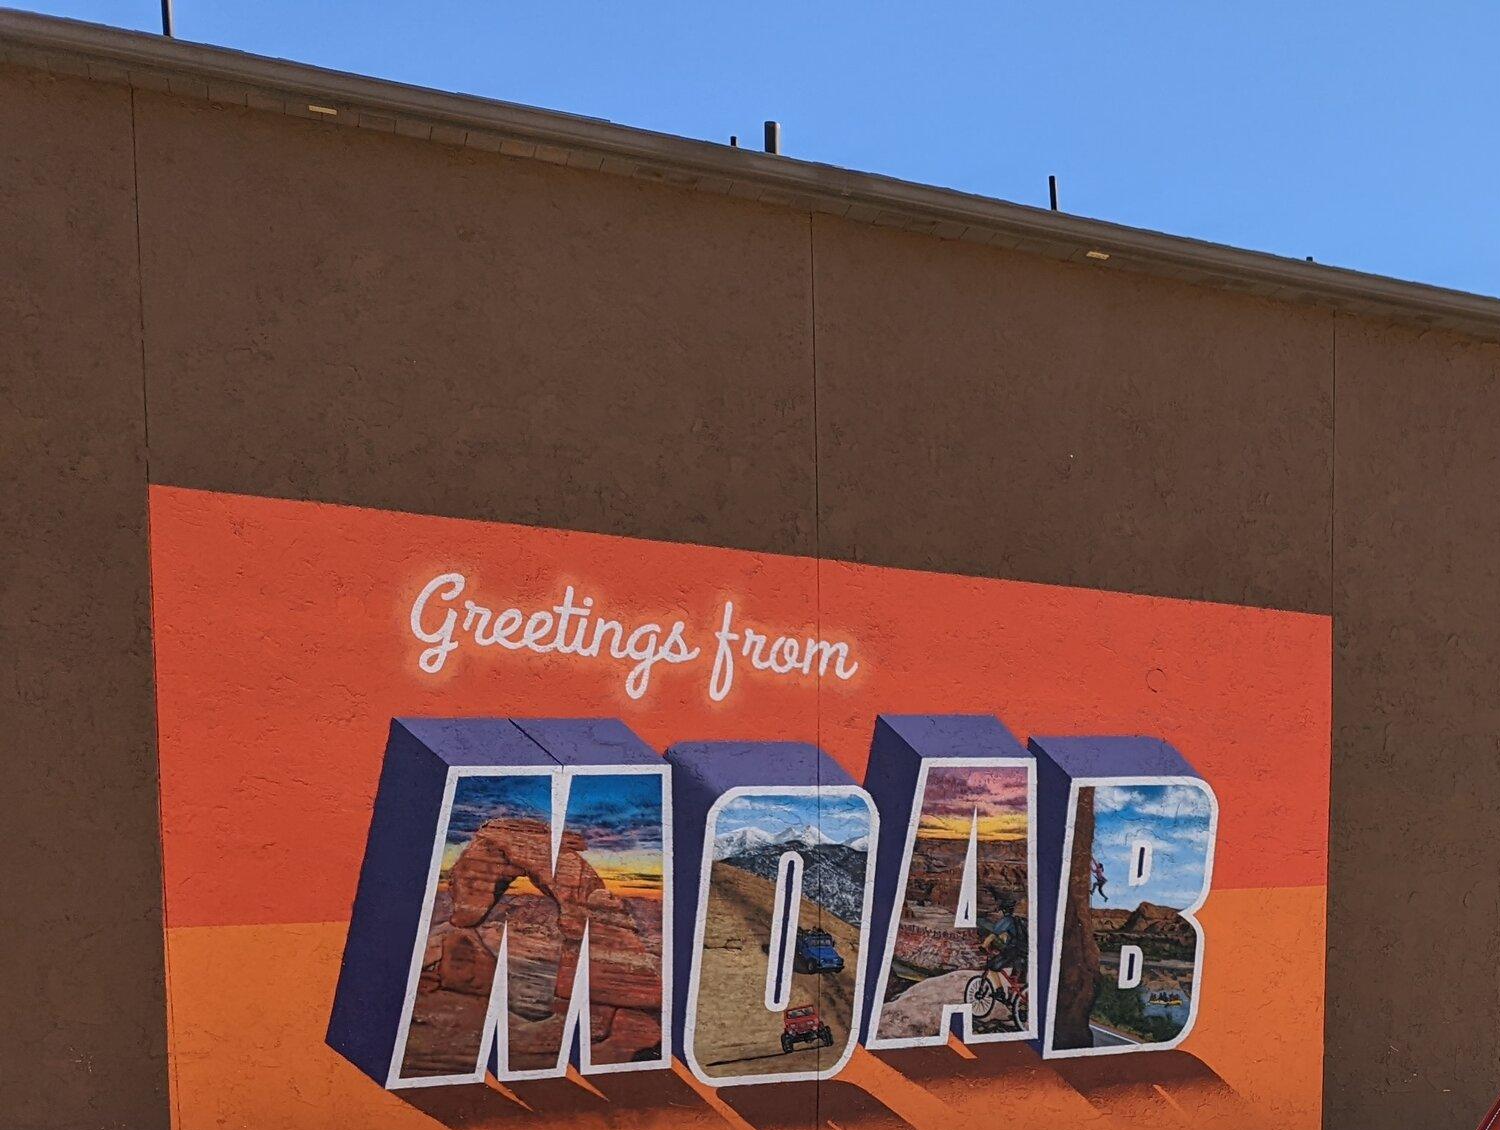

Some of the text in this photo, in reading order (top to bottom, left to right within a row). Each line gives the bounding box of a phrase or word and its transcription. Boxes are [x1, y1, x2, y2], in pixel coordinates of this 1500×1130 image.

[409, 572, 859, 702] Greetings from
[328, 715, 1220, 1088] MOAB
